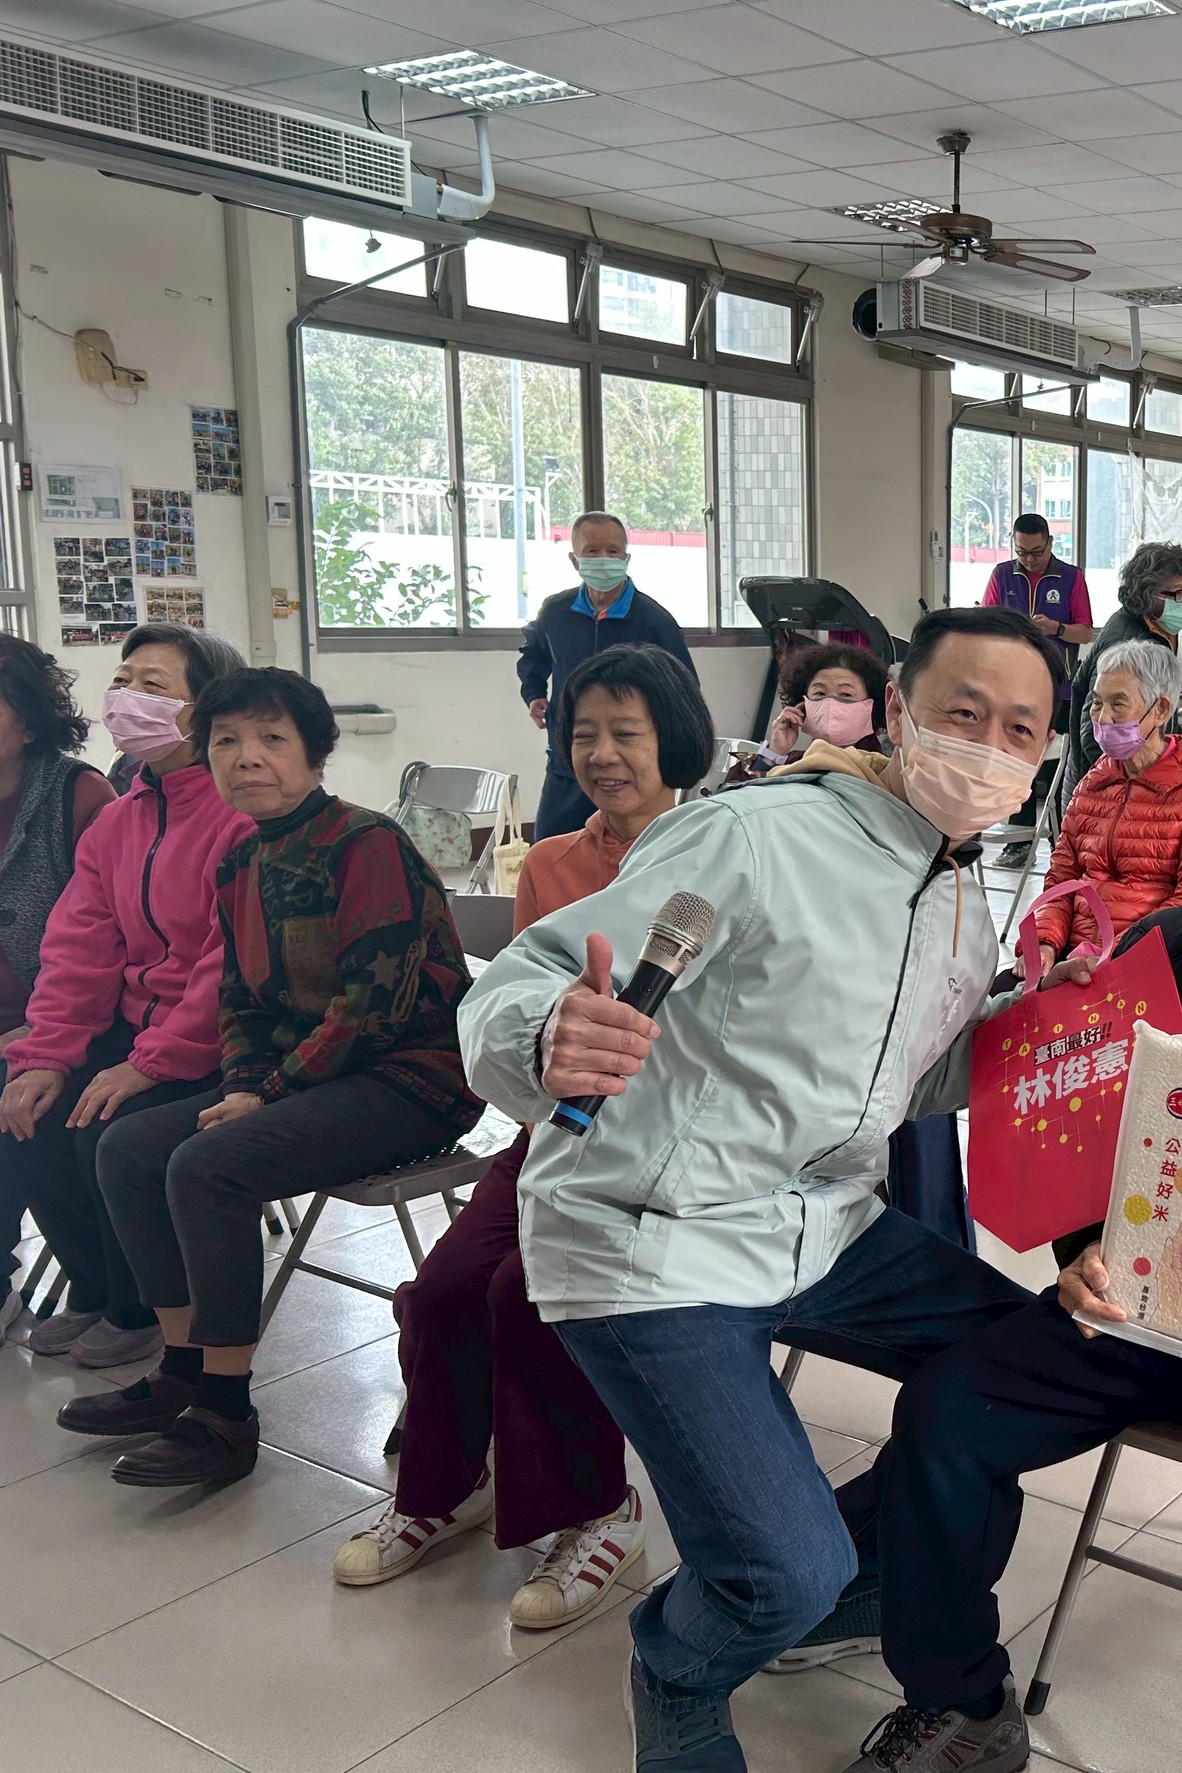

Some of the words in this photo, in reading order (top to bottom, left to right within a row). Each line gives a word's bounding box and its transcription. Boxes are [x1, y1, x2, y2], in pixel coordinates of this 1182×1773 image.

[1013, 1038, 1130, 1116] 林俊憲
[1152, 1137, 1181, 1223] 公益好米
